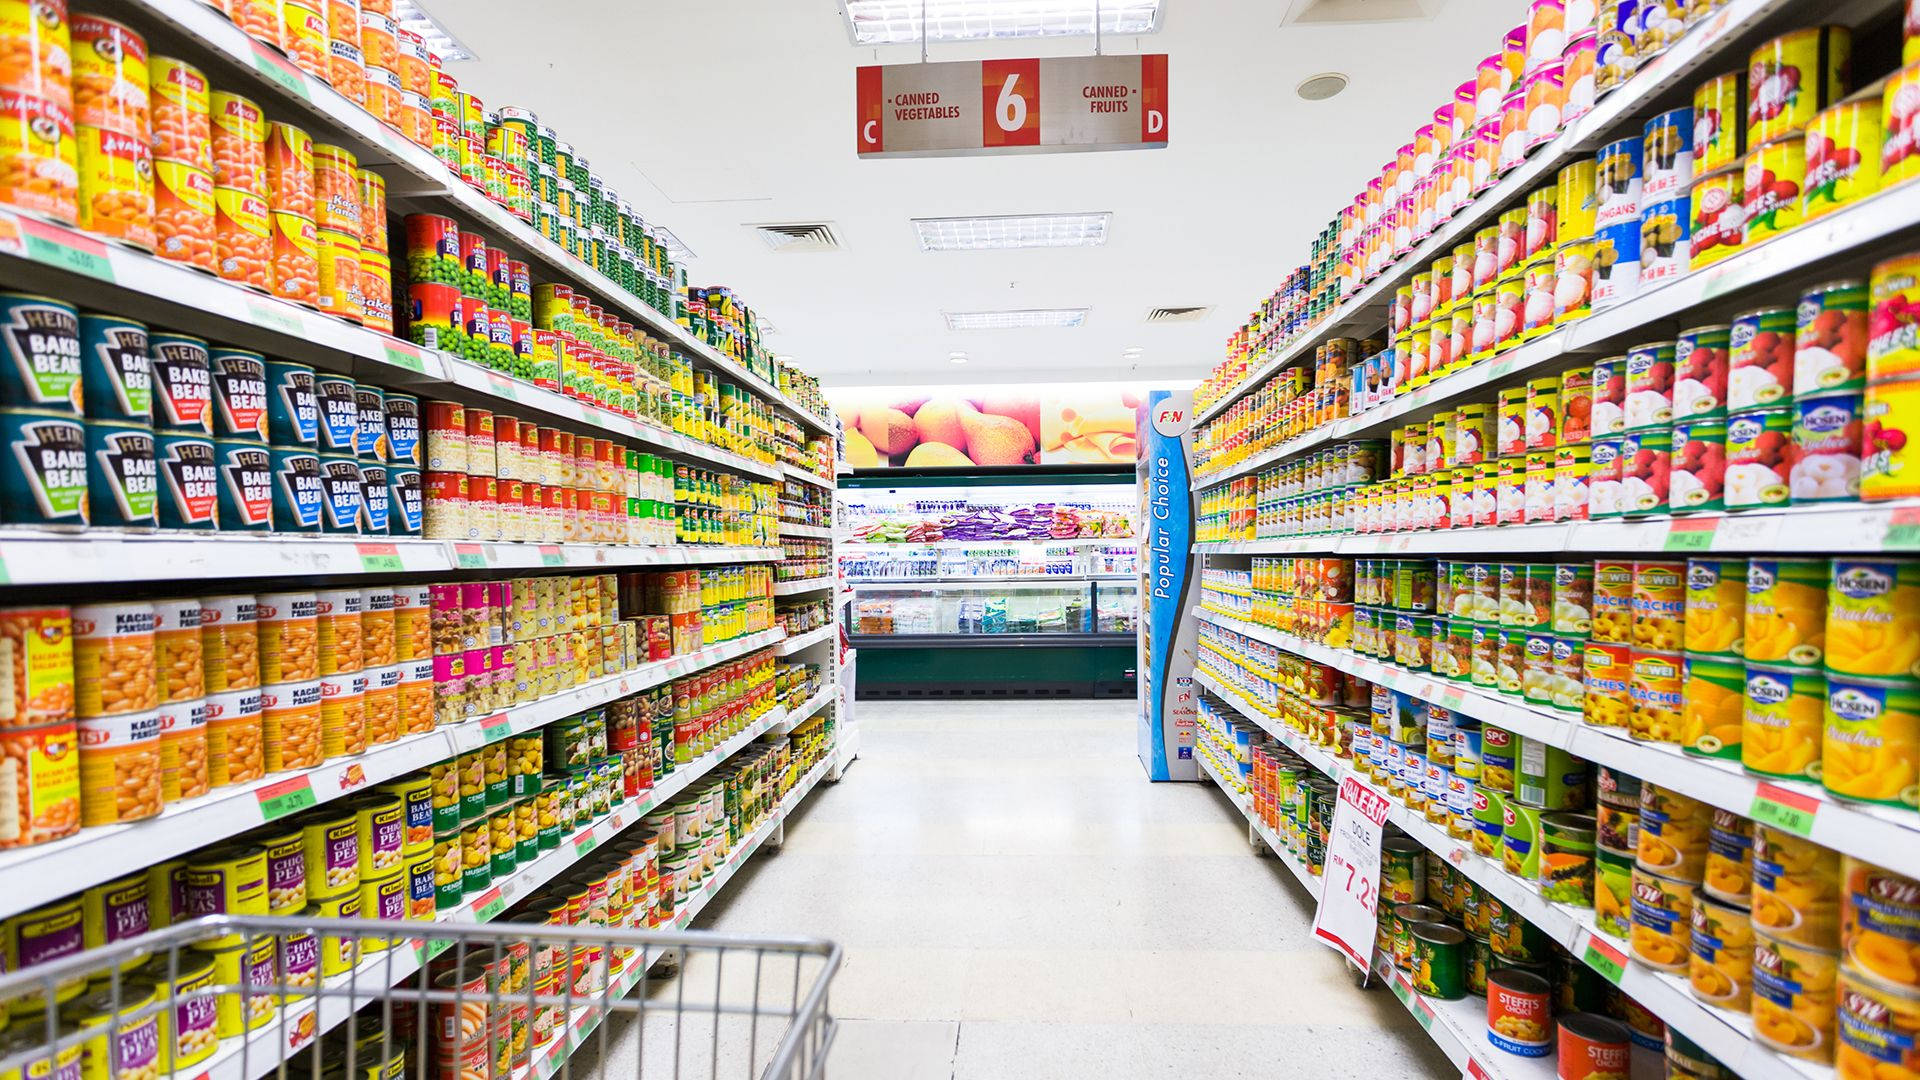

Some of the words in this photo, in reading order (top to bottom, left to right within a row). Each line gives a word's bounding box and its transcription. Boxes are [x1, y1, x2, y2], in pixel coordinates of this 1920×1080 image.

[895, 92, 940, 106] CANNED
[1082, 85, 1128, 98] CANNED
[995, 73, 1027, 131] 6
[1090, 100, 1129, 113] FRUITS
[895, 106, 960, 121] VEGETABLES
[1147, 110, 1163, 133] D
[863, 120, 876, 144] C
[1804, 413, 1847, 427] HOSEN
[1152, 457, 1170, 521] Choice
[1152, 527, 1170, 599] Popular
[1838, 576, 1886, 591] HOSEN
[1831, 697, 1875, 715] HOSEN
[1486, 730, 1508, 743] SPC
[1352, 820, 1370, 847] DOLE
[1346, 862, 1378, 917] 7.25
